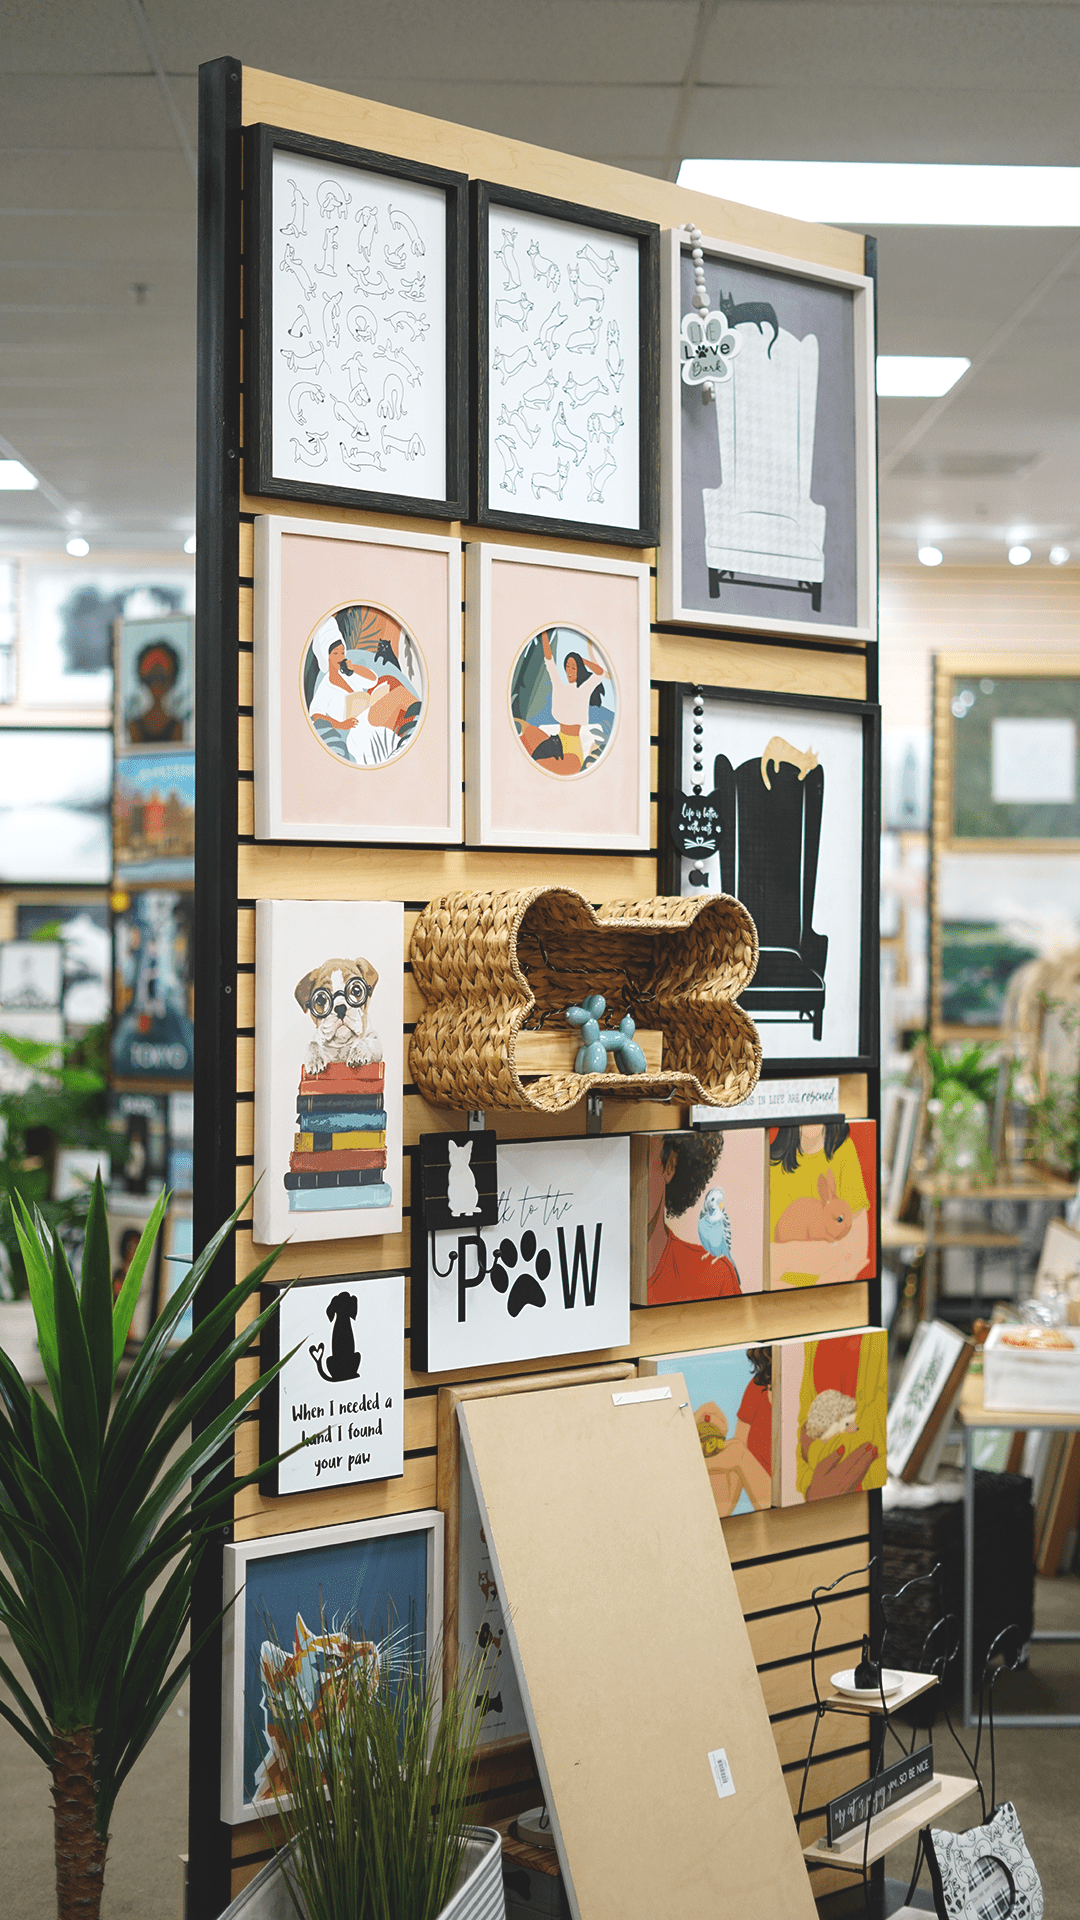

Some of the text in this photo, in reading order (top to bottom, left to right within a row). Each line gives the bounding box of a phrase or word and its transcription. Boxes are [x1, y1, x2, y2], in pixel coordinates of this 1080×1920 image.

[684, 343, 730, 359] Lve
[692, 359, 722, 377] Bark
[681, 802, 719, 822] Life is better
[758, 1095, 766, 1105] IN
[769, 1094, 785, 1105] LIFE
[788, 1093, 800, 1104] ARE
[497, 1183, 574, 1228] lk to the
[458, 1222, 603, 1323] PW
[291, 1391, 393, 1422] When I needed a
[301, 1417, 383, 1448] hand I found
[314, 1452, 371, 1477] your paw
[834, 1808, 846, 1831] my
[847, 1795, 860, 1823] cat
[864, 1786, 886, 1816] juging
[899, 1771, 908, 1785] SO
[908, 1766, 916, 1780] BE
